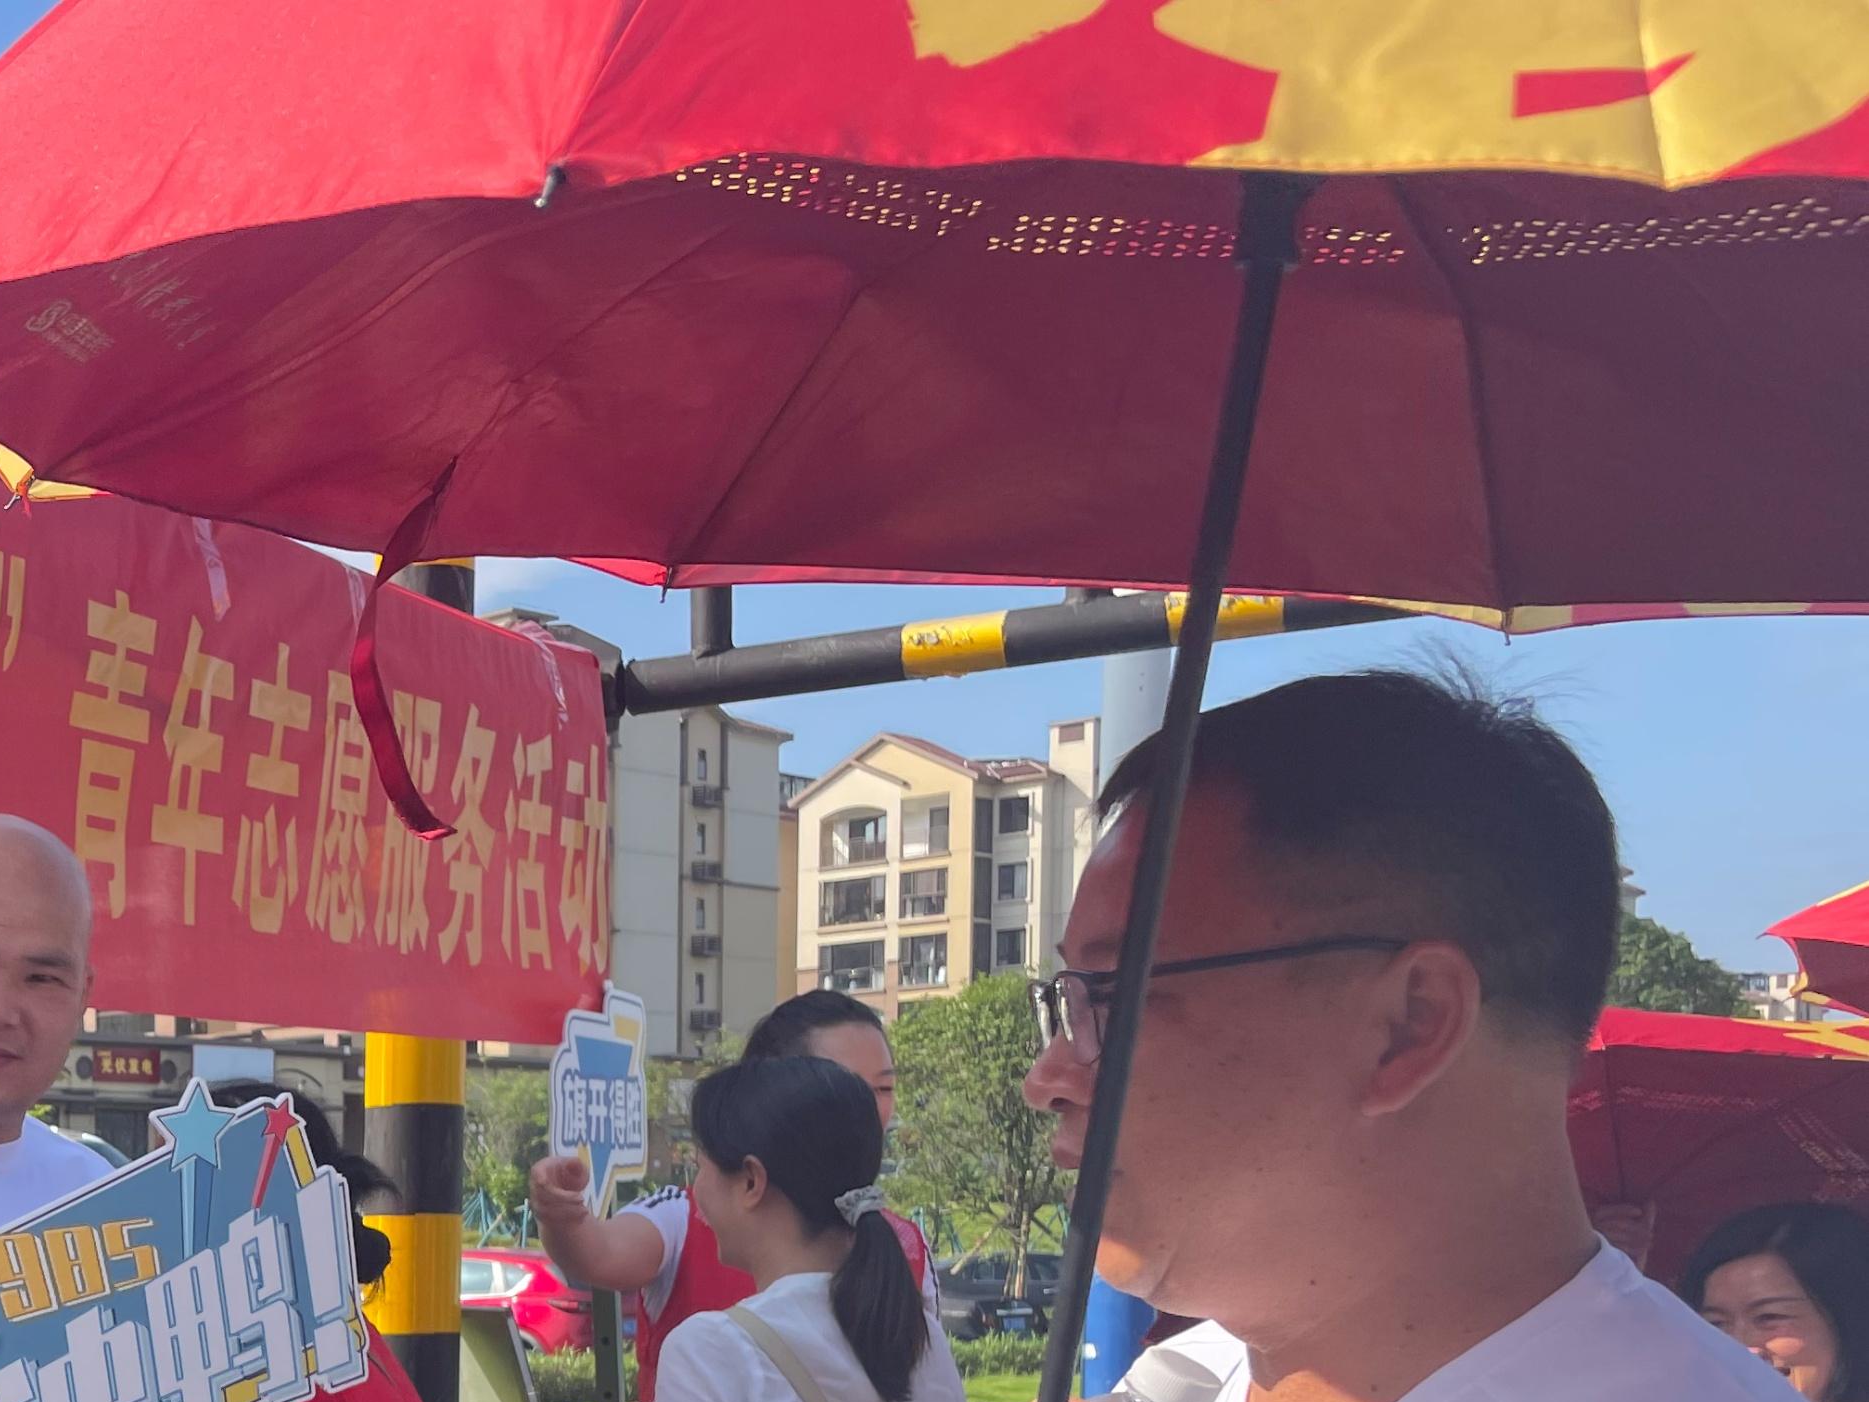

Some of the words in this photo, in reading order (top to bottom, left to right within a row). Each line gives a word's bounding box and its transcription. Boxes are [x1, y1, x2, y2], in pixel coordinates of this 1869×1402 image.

[69, 589, 608, 975] 青年志愿服务活动
[562, 1069, 642, 1149] 旗开得胜
